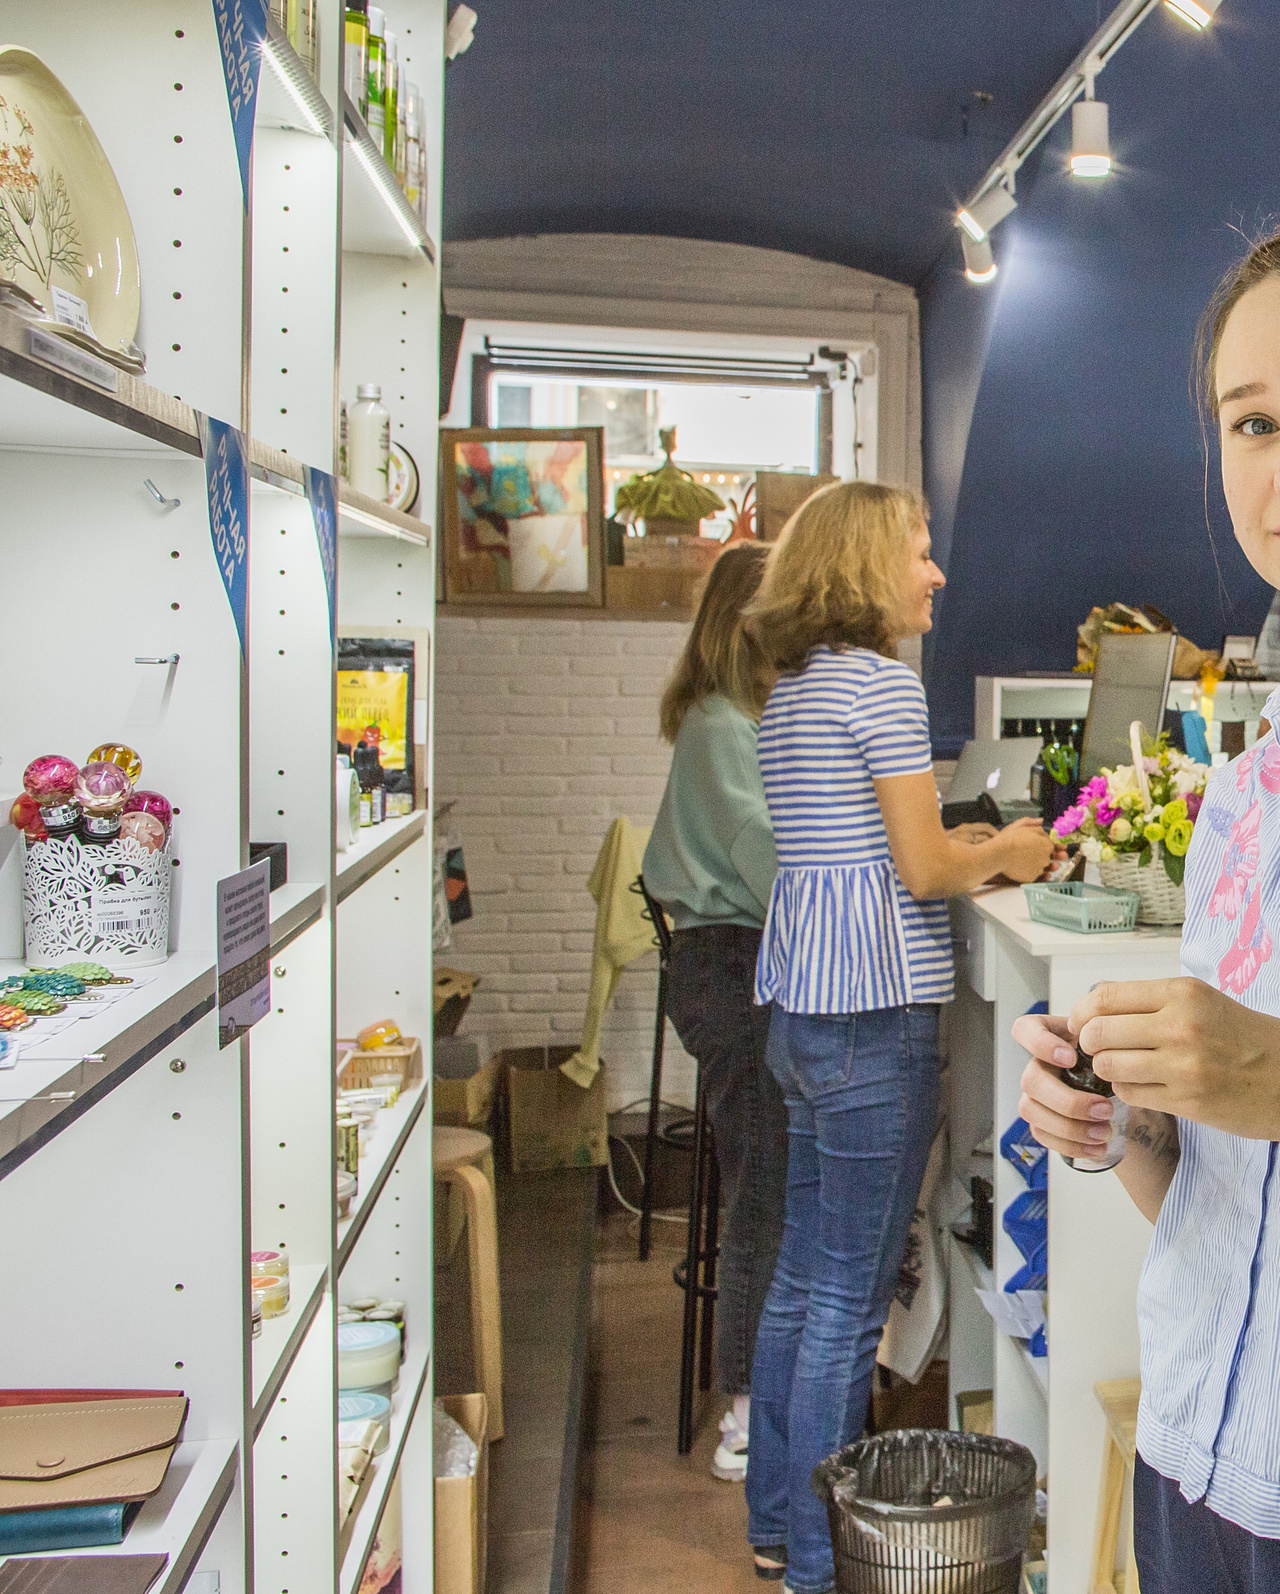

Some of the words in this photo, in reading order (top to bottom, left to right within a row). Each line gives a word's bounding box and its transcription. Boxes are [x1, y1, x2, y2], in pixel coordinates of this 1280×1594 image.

[209, 470, 235, 589] РАБОТА
[218, 433, 246, 565] РУЧНАЯ
[62, 811, 76, 821] 950
[139, 908, 151, 916] 950
